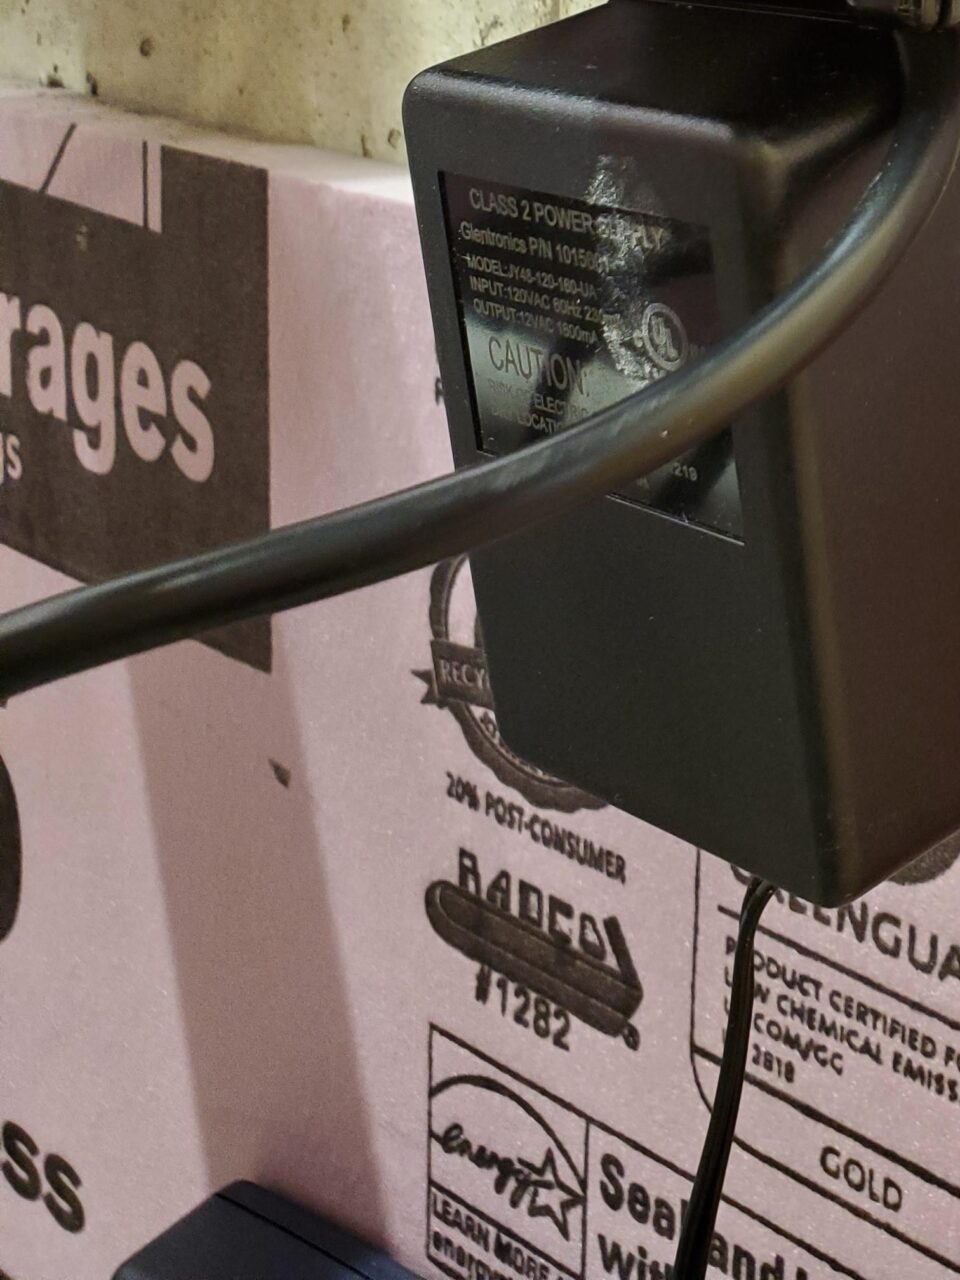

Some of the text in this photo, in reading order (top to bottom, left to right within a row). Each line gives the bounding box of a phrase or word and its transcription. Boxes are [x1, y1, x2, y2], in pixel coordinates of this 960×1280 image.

[460, 221, 526, 254] Glentronics
[529, 237, 553, 260] P/N
[469, 188, 519, 218] CLASS
[520, 200, 531, 220] 2
[534, 202, 594, 234] POWER
[0, 291, 215, 483] rages
[486, 790, 627, 885] POST-CONSUMER
[474, 963, 571, 1051] #1282
[726, 935, 823, 1002] PODUCT
[829, 989, 937, 1059] CERTIFIED
[776, 994, 883, 1065] CHEMICAL
[819, 1145, 902, 1213] GOLD
